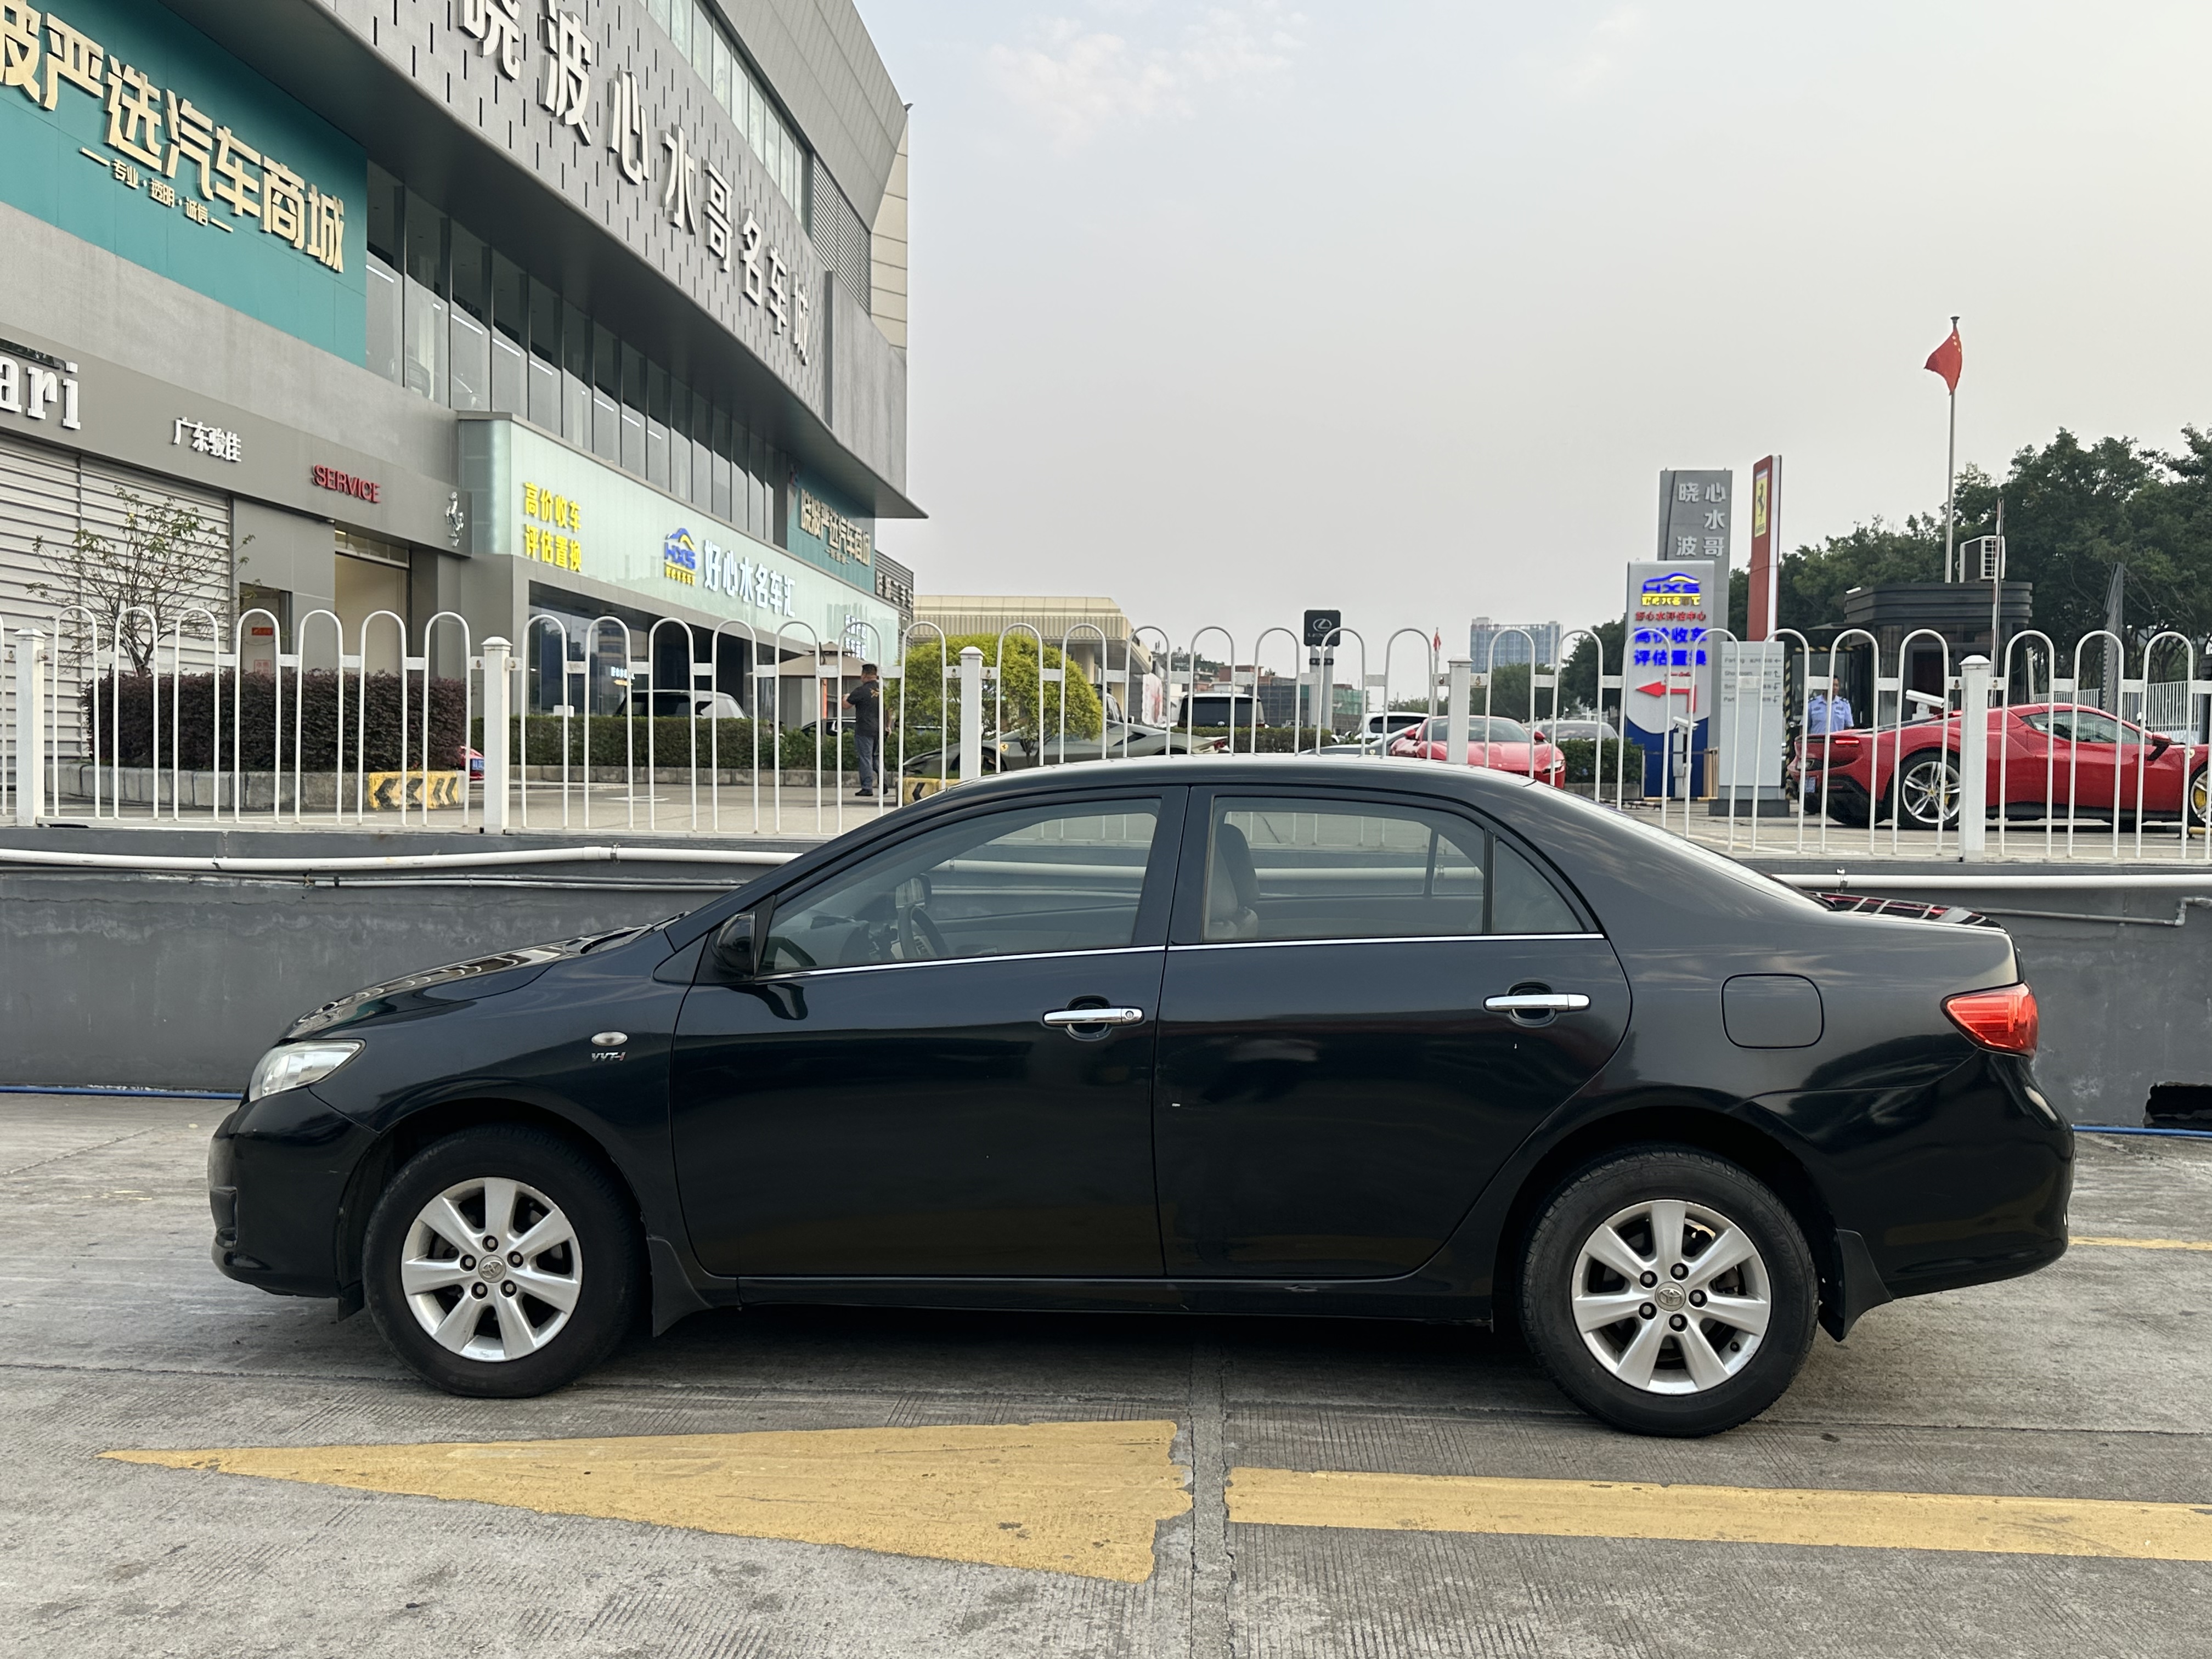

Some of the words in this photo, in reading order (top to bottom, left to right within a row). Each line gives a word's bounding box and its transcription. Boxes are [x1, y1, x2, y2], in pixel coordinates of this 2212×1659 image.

[173, 416, 242, 462] 广东骏佳
[312, 464, 381, 504] SERVICE
[523, 482, 582, 533] 高价收车
[524, 523, 582, 572] 评估置换
[664, 541, 696, 569] HXS
[704, 539, 794, 618] 好心水名车汇
[1643, 583, 1700, 594] HXS
